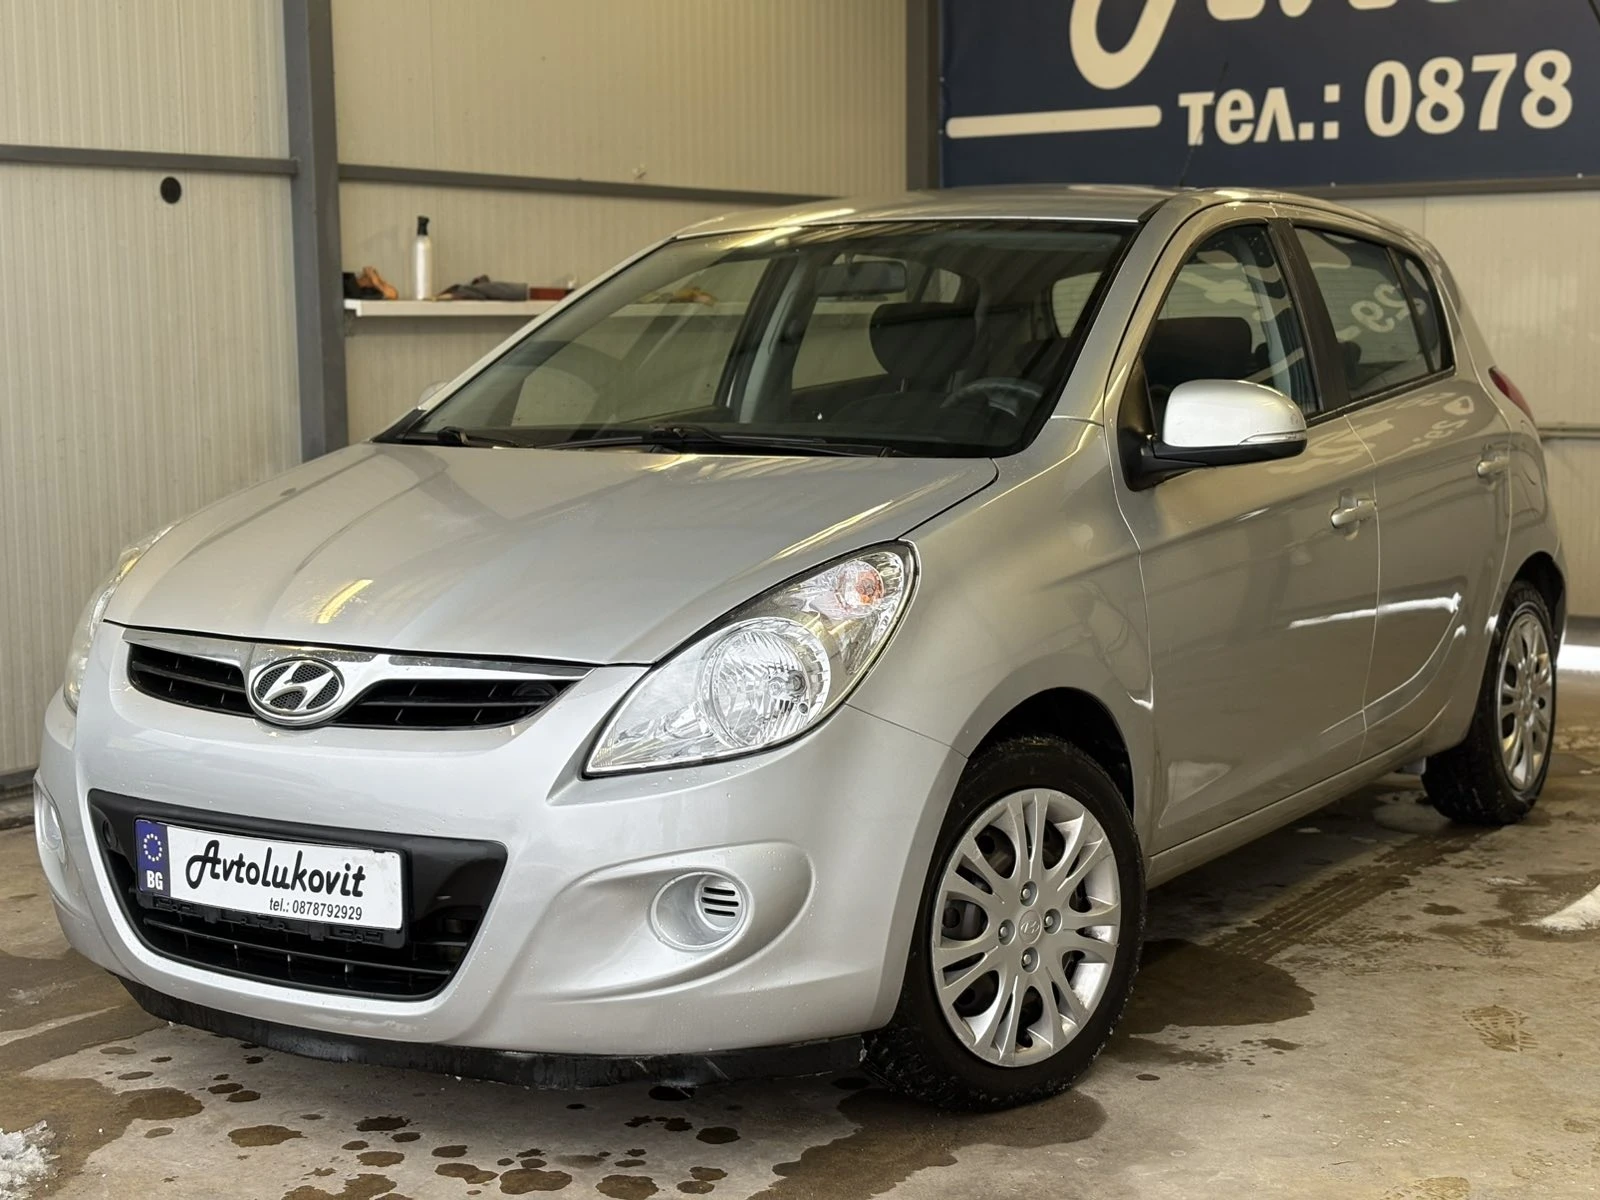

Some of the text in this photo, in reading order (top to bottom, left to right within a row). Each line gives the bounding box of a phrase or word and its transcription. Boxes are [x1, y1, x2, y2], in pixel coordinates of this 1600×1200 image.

[1178, 49, 1573, 145] тел.: 0878
[146, 870, 163, 891] BG
[185, 839, 366, 898] Avtolukovit
[269, 898, 363, 921] tel.: 0878792929
